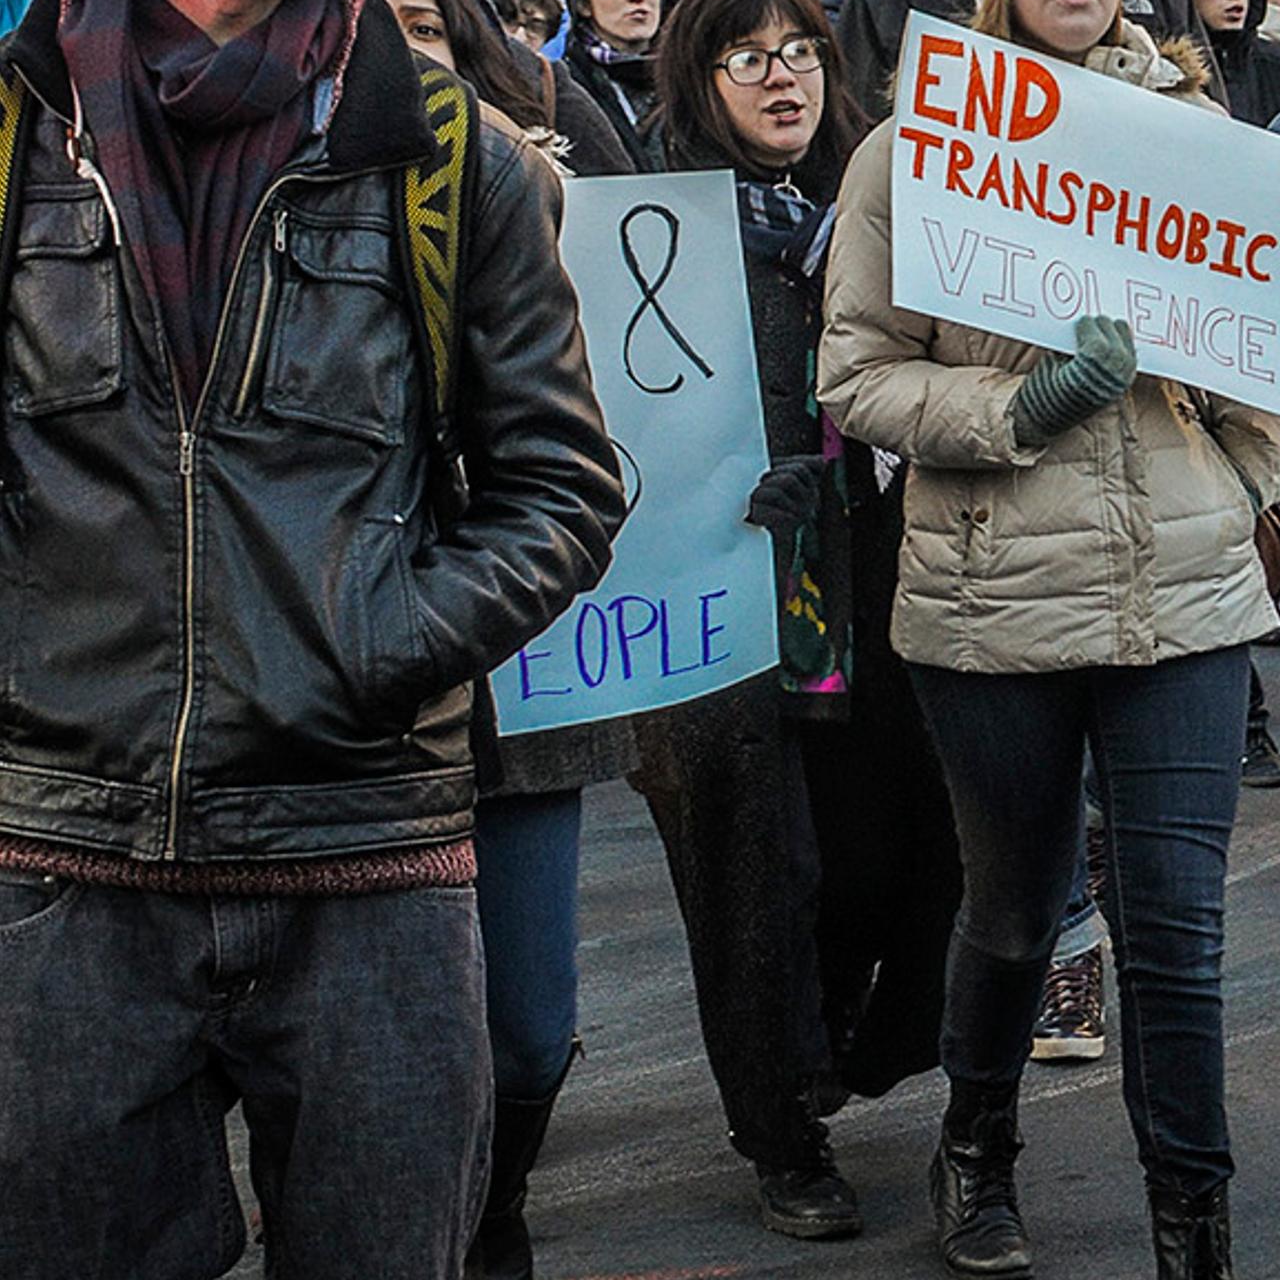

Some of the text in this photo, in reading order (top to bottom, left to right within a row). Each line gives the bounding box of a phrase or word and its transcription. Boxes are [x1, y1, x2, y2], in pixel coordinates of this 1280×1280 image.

[914, 34, 1062, 142] END
[899, 128, 1278, 283] TRANSPHOBIC
[518, 589, 731, 701] EOPLE
